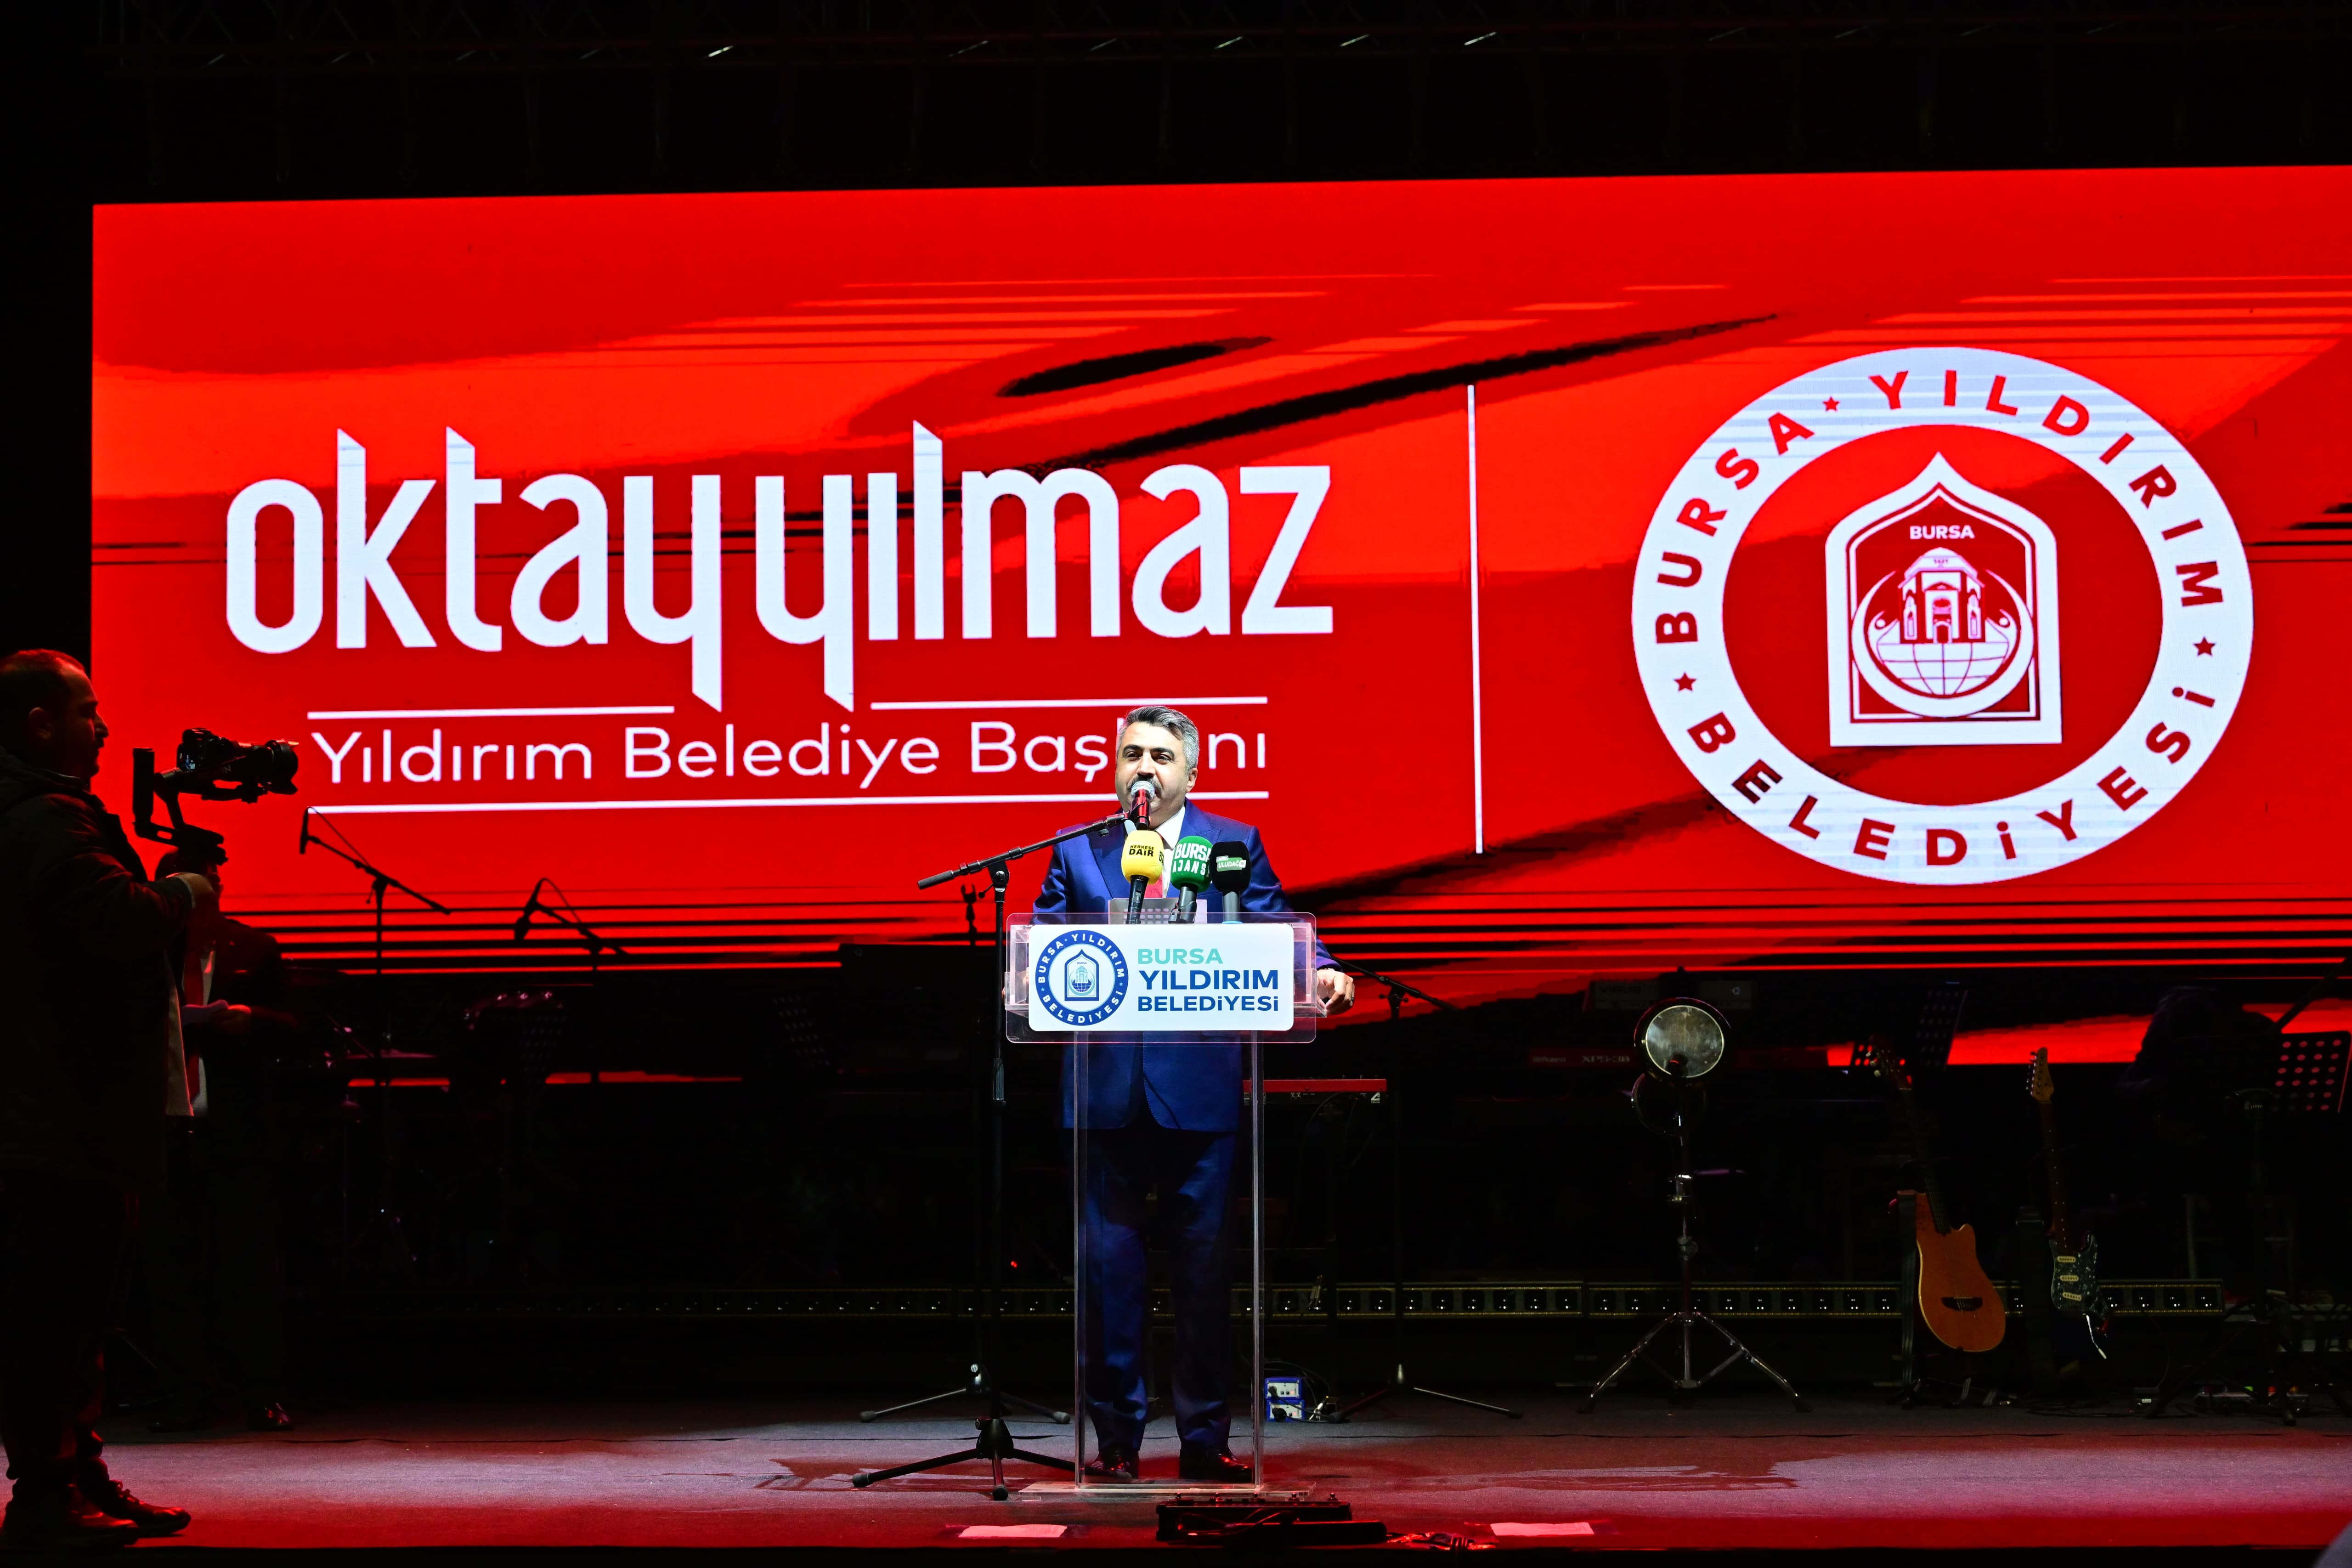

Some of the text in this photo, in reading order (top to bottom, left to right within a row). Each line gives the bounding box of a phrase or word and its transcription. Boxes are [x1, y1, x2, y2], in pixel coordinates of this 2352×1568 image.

[1655, 370, 2224, 644] BURSA YILDIRIM
[1910, 525, 1975, 539] BURSA
[312, 719, 1266, 789] Yıldırım Belediye Başnı
[1038, 934, 1125, 983] BURSA YILDIRIM
[1138, 948, 1223, 964] BURSA
[1139, 970, 1278, 990] YILDIRIM
